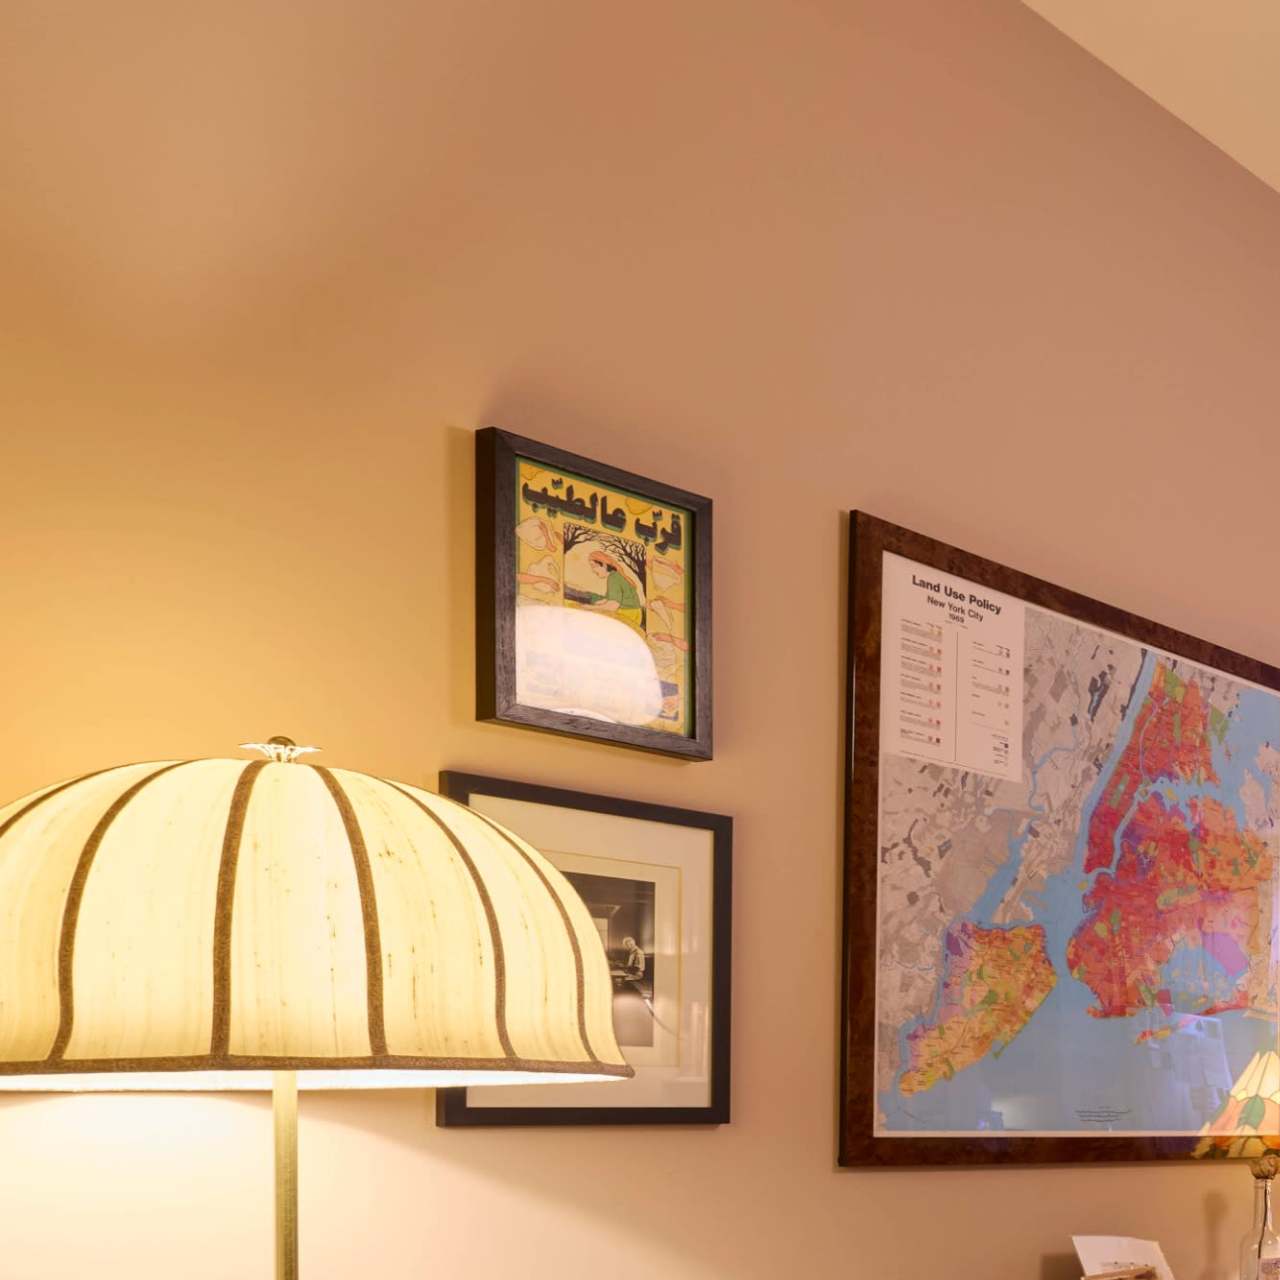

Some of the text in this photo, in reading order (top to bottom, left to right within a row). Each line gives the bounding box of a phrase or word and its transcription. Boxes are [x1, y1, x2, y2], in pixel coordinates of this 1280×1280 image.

[912, 575, 1002, 615] Land Use Policy
[927, 595, 984, 622] New York City
